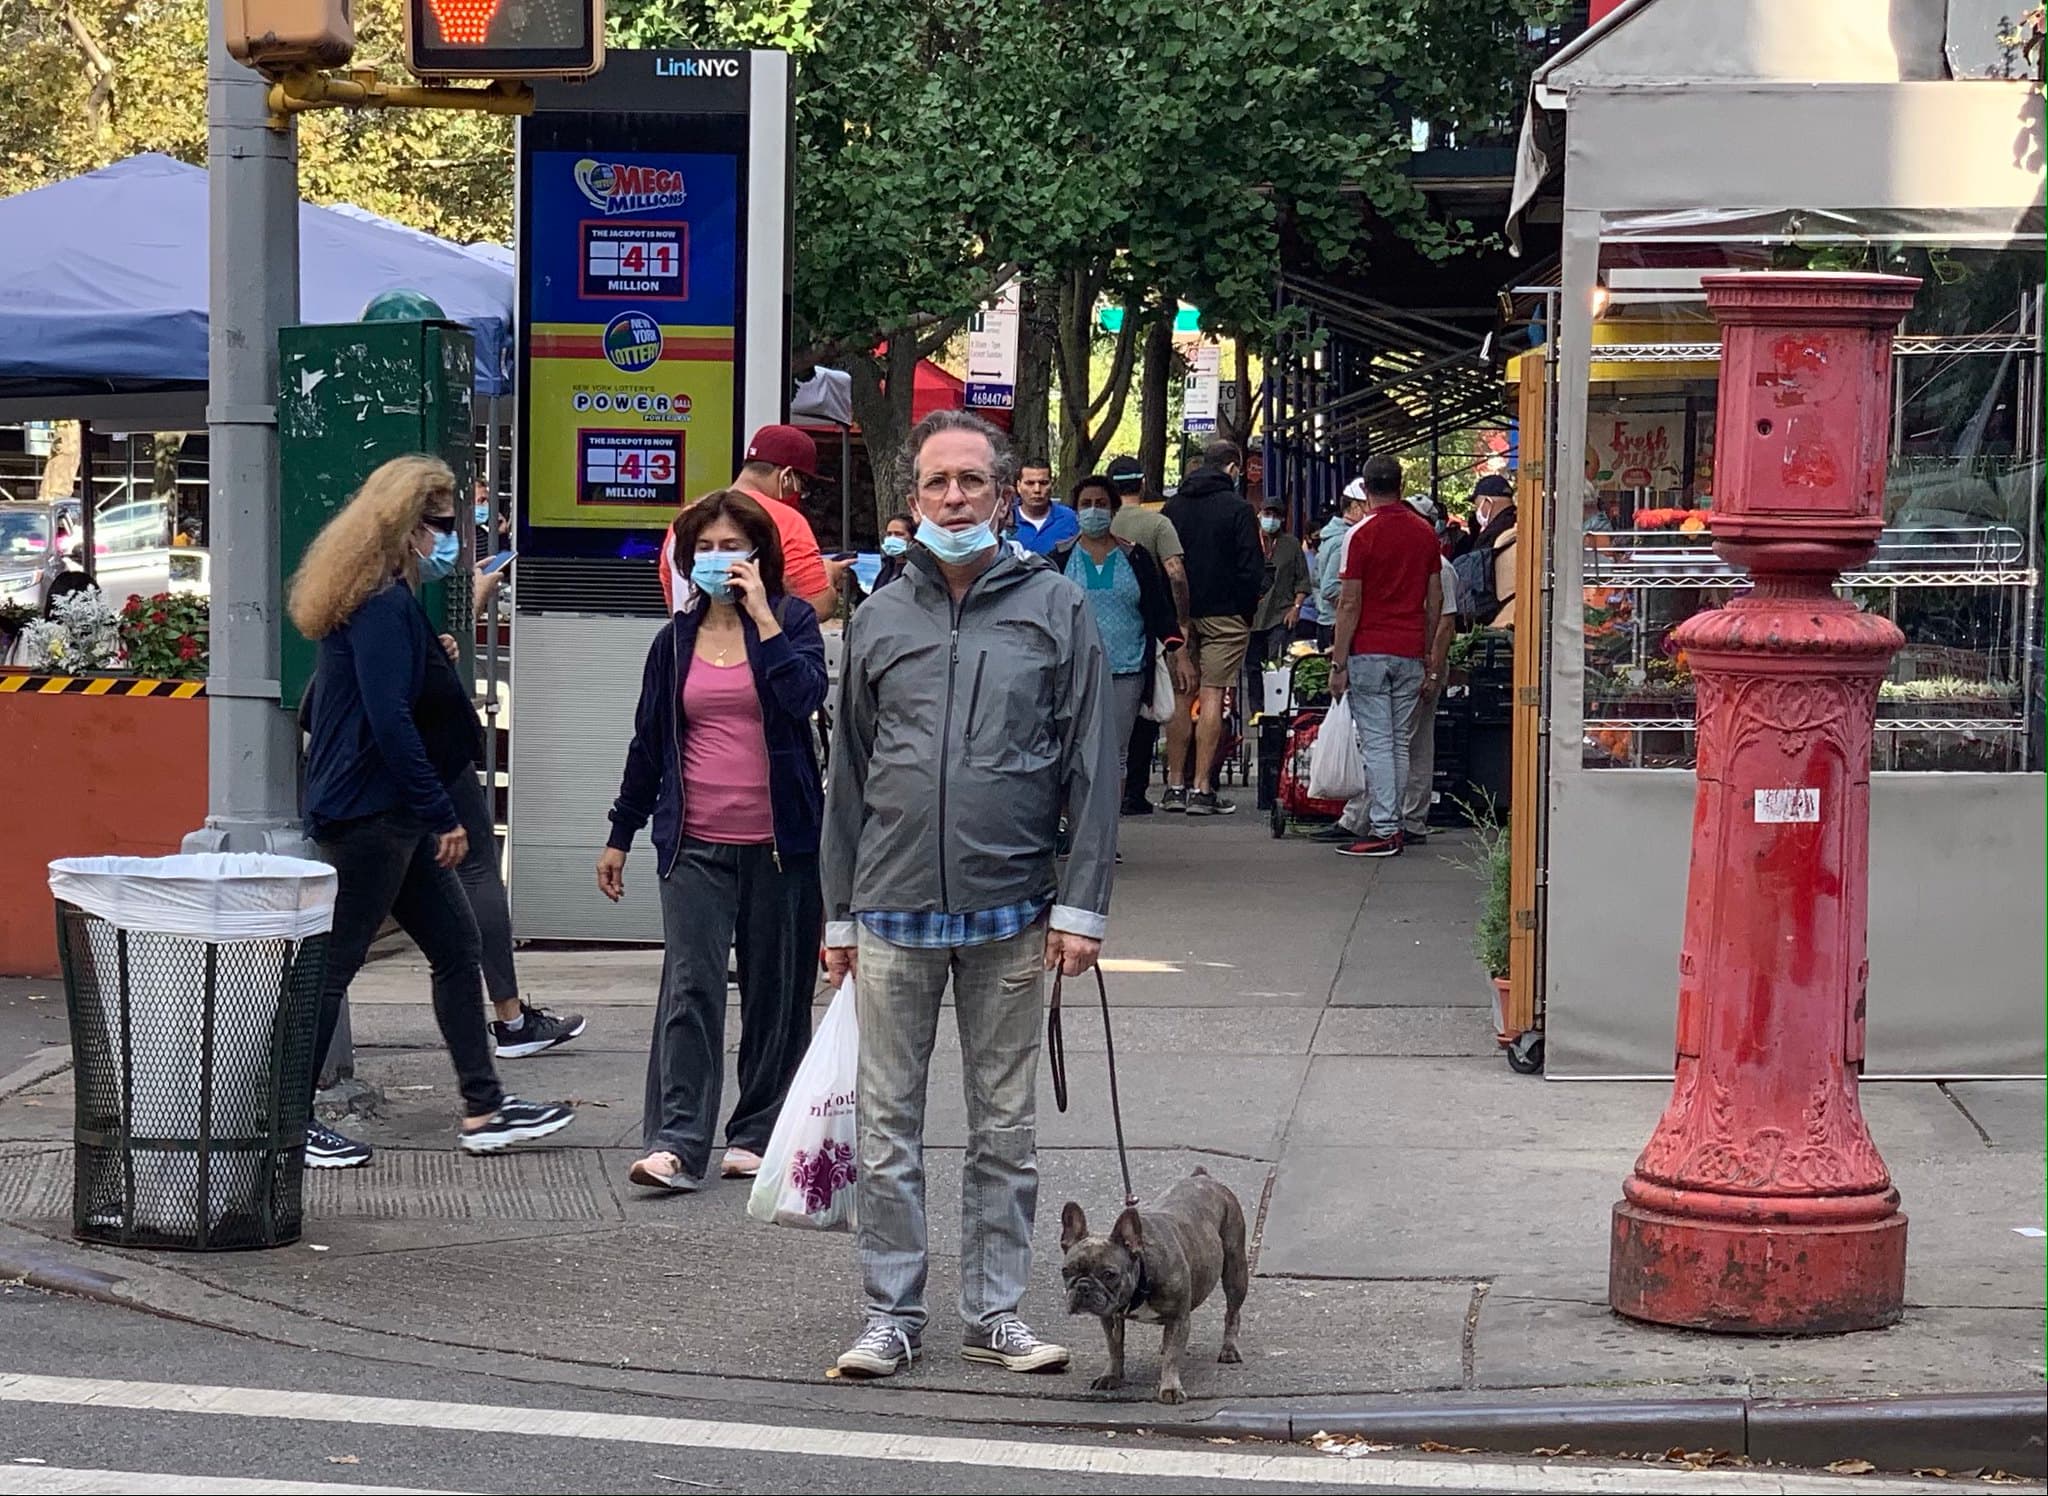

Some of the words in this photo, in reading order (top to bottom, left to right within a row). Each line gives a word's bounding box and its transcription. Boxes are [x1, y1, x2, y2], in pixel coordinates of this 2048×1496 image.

[655, 57, 740, 78] LinkNYC
[612, 165, 684, 195] MEGA
[606, 192, 685, 214] MILLIONS
[591, 229, 608, 238] THE
[608, 229, 647, 238] JACKPOT
[647, 230, 655, 238] IS
[656, 230, 676, 239] NOW
[608, 280, 660, 291] MILLION
[630, 318, 651, 330] NEW
[633, 329, 658, 344] YORK
[610, 343, 660, 365] LOTTERY
[572, 384, 590, 392] NEW
[614, 385, 656, 393] LOTTERY'S
[1218, 385, 1237, 400] TO
[972, 392, 1002, 406] 468447
[589, 437, 606, 445] THE
[606, 437, 643, 446] JACKPOT
[644, 438, 652, 446] IS
[653, 438, 673, 447] NOW
[1609, 420, 1670, 452] Fresh
[605, 487, 657, 499] MILLION
